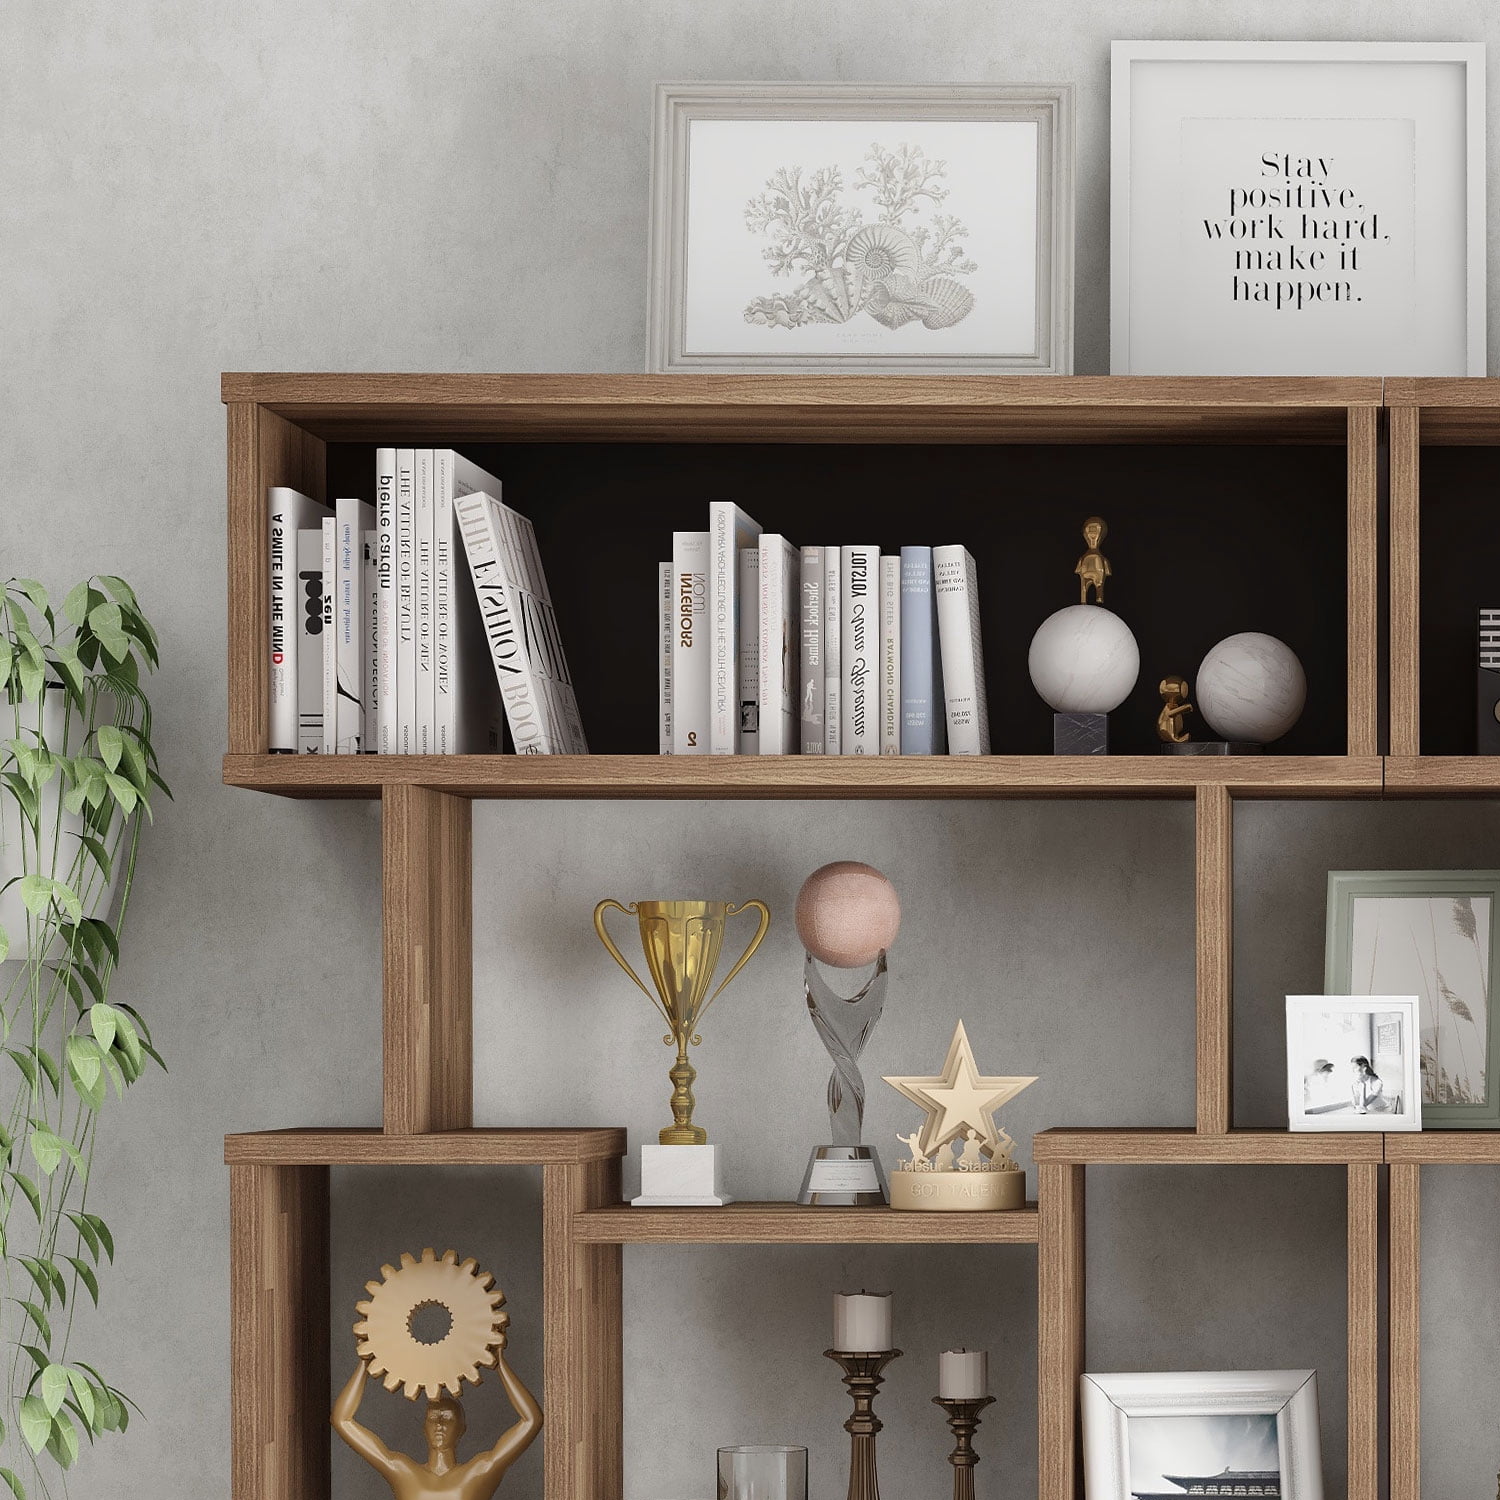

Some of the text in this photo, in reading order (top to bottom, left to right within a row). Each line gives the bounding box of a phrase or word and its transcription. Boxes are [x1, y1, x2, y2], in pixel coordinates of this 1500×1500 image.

[1261, 152, 1334, 186] Stay
[1202, 214, 1284, 239] work
[1235, 242, 1362, 271] make it
[1232, 276, 1362, 310] happen.
